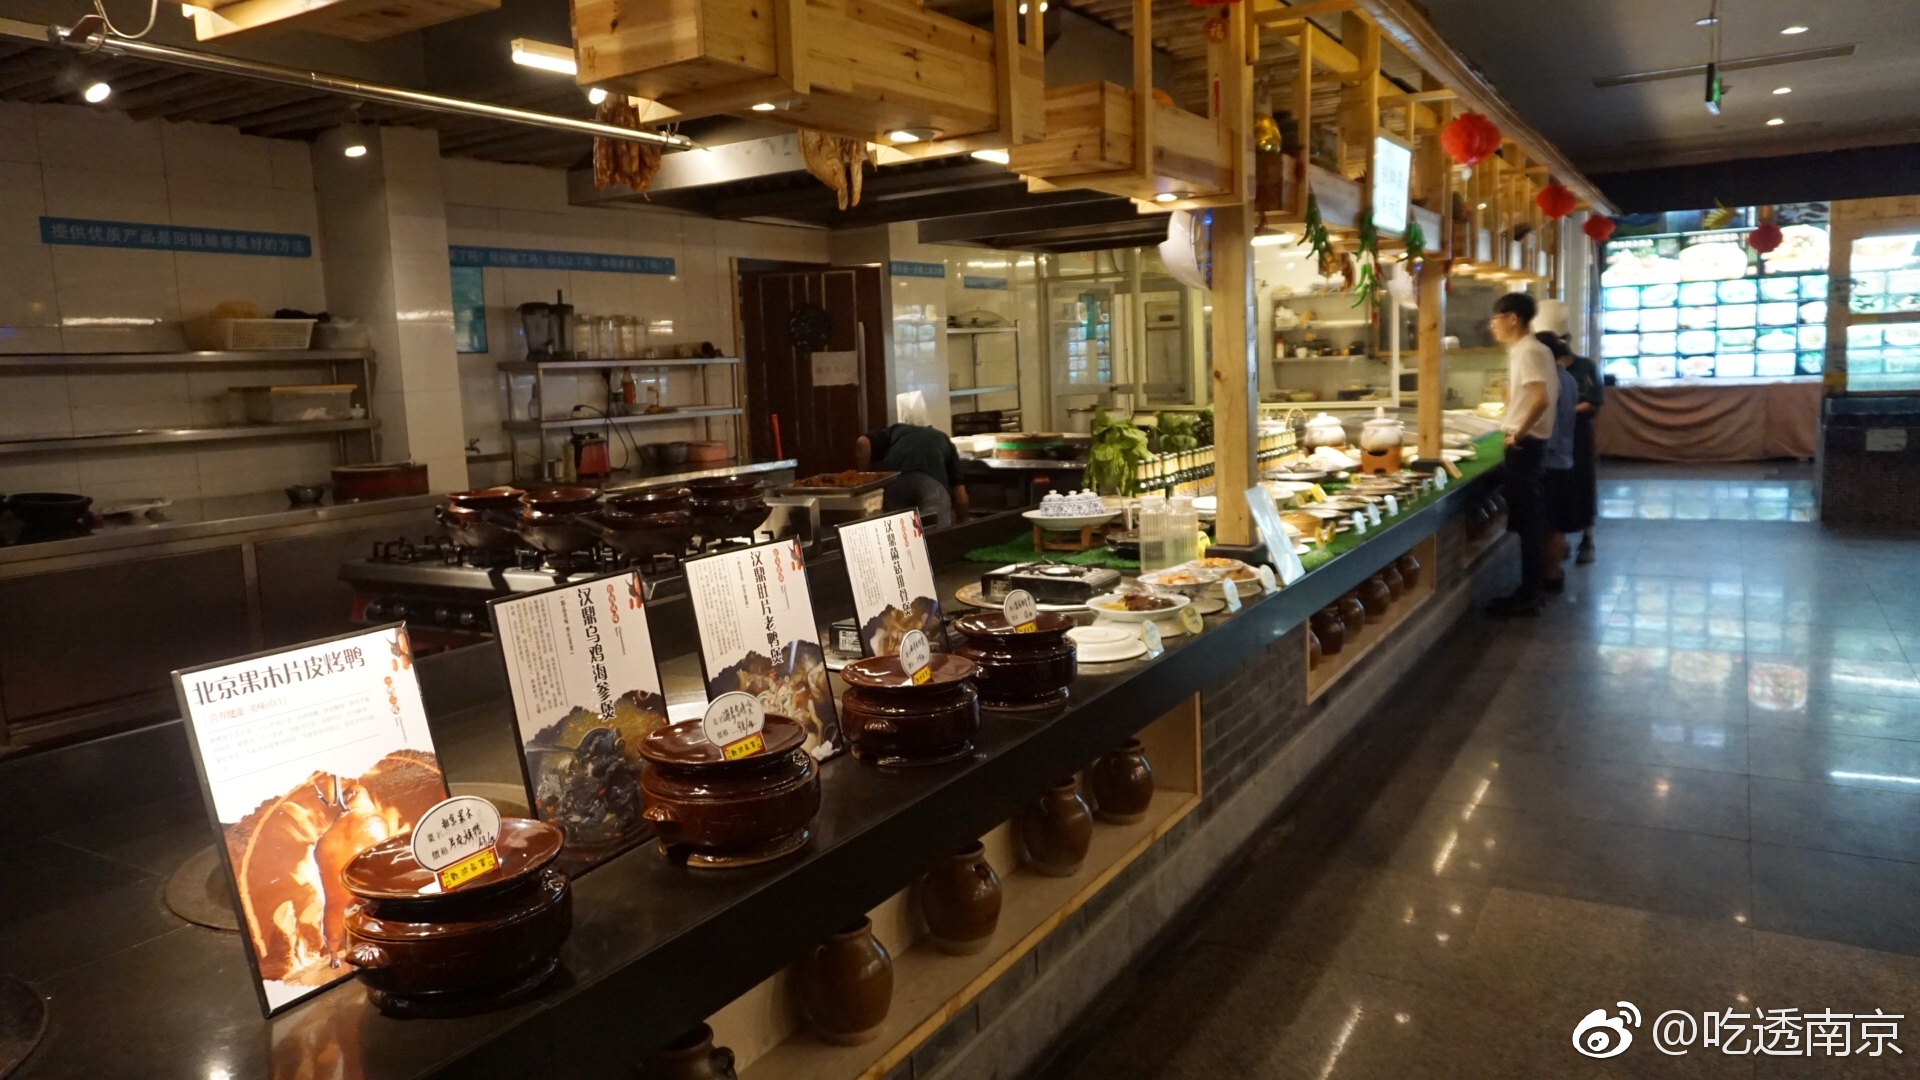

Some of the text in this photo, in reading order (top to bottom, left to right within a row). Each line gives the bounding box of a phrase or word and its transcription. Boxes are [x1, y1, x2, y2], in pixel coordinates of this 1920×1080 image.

[750, 550, 785, 666] 汉鼎肚片老鸭煲
[883, 519, 912, 616] 汉鼎菌菇排骨煲
[192, 645, 366, 706] 北京果木片皮烤鸭
[577, 587, 616, 722] 汉鼎乌鸡海参煲
